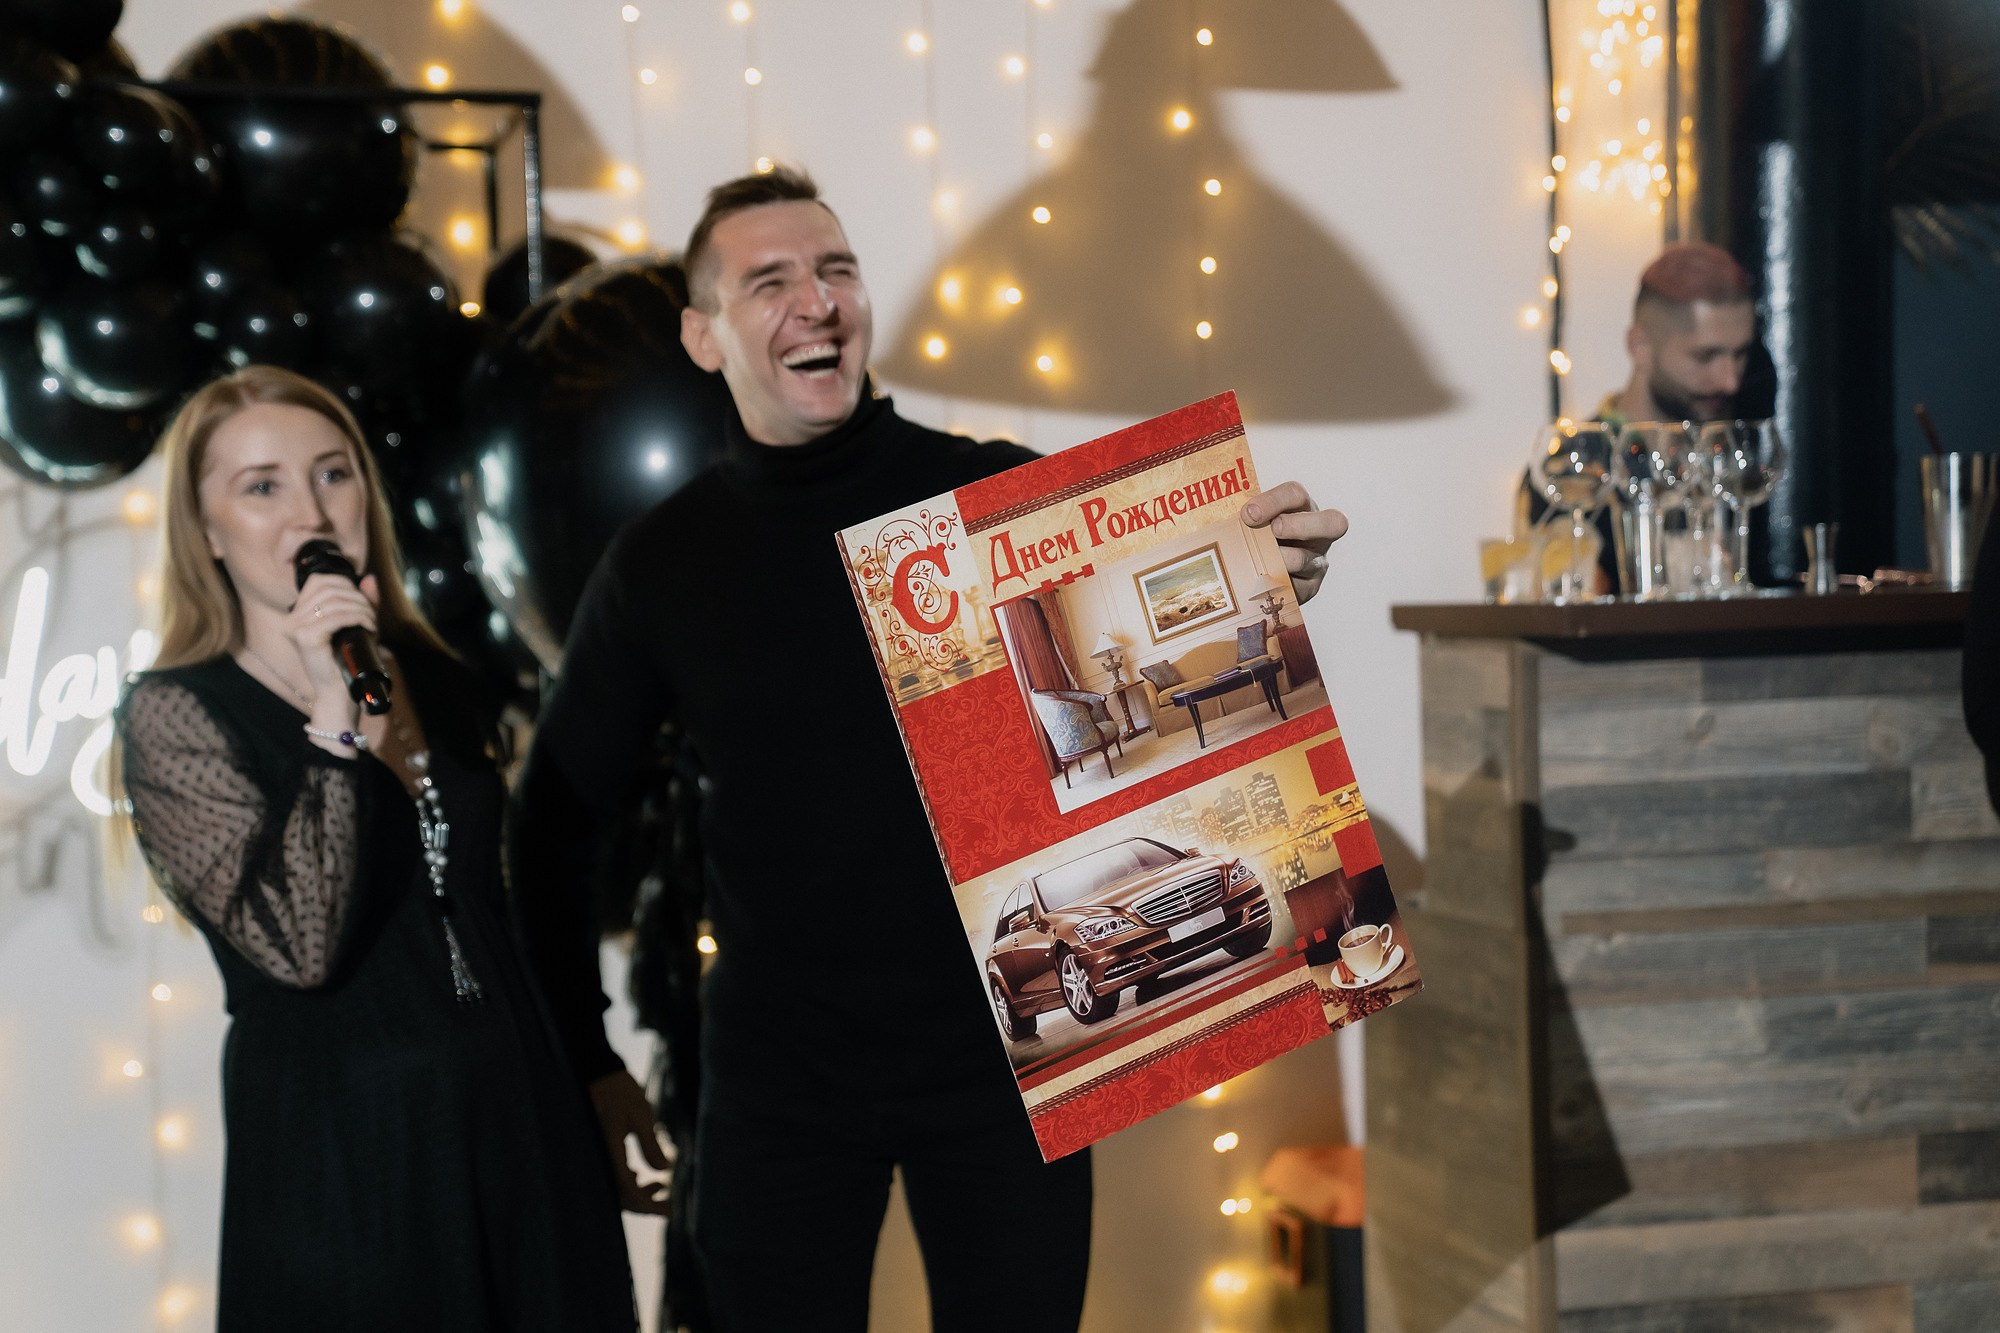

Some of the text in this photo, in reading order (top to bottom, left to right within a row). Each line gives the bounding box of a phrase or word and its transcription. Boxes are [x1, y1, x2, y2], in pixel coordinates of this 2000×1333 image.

[891, 457, 1250, 635] С Днем Рождения!
